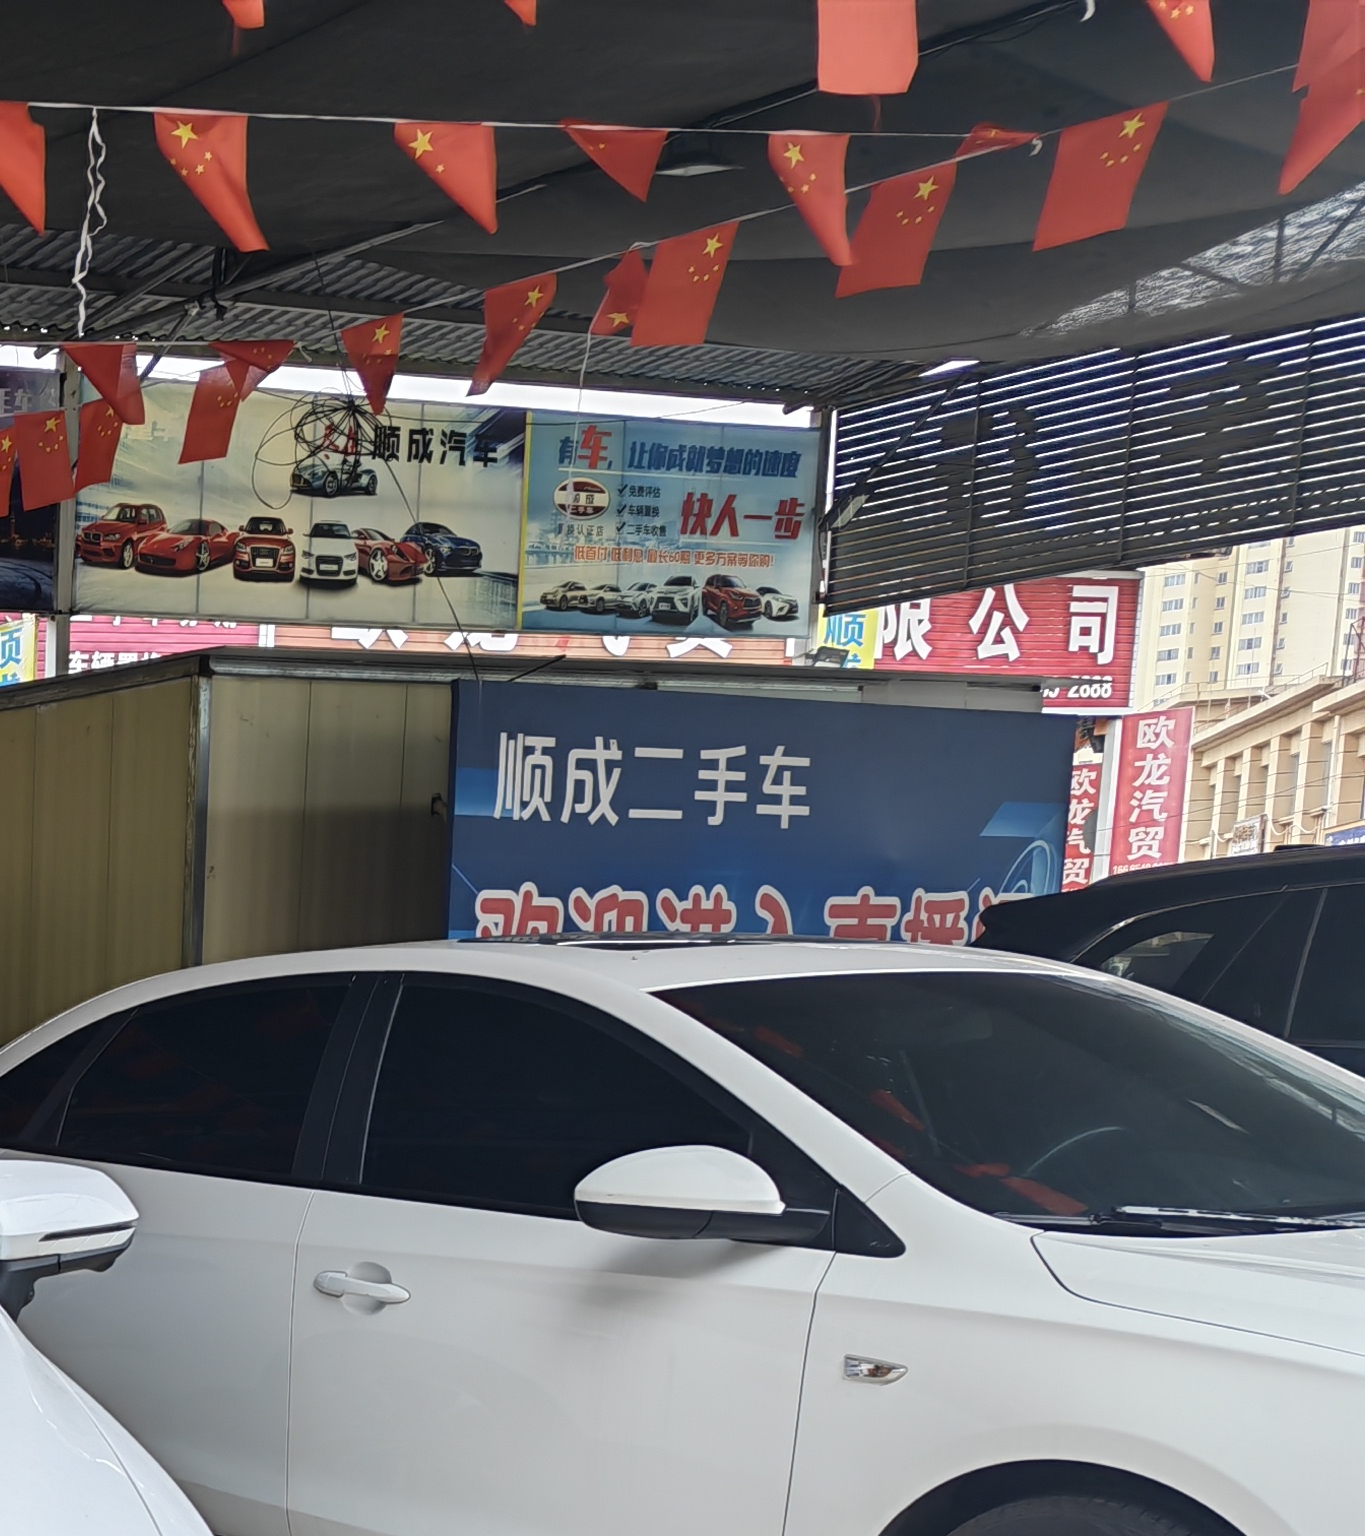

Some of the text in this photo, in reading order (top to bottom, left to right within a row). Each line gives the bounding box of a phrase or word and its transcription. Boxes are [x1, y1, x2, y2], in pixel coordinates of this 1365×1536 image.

[372, 425, 498, 468] 顺成汽车
[627, 441, 802, 478] 让你成就梦想的速度
[679, 491, 805, 541] 快人一步
[493, 732, 811, 829] 顺成二手车
[1126, 714, 1176, 862] 欧龙汽贸
